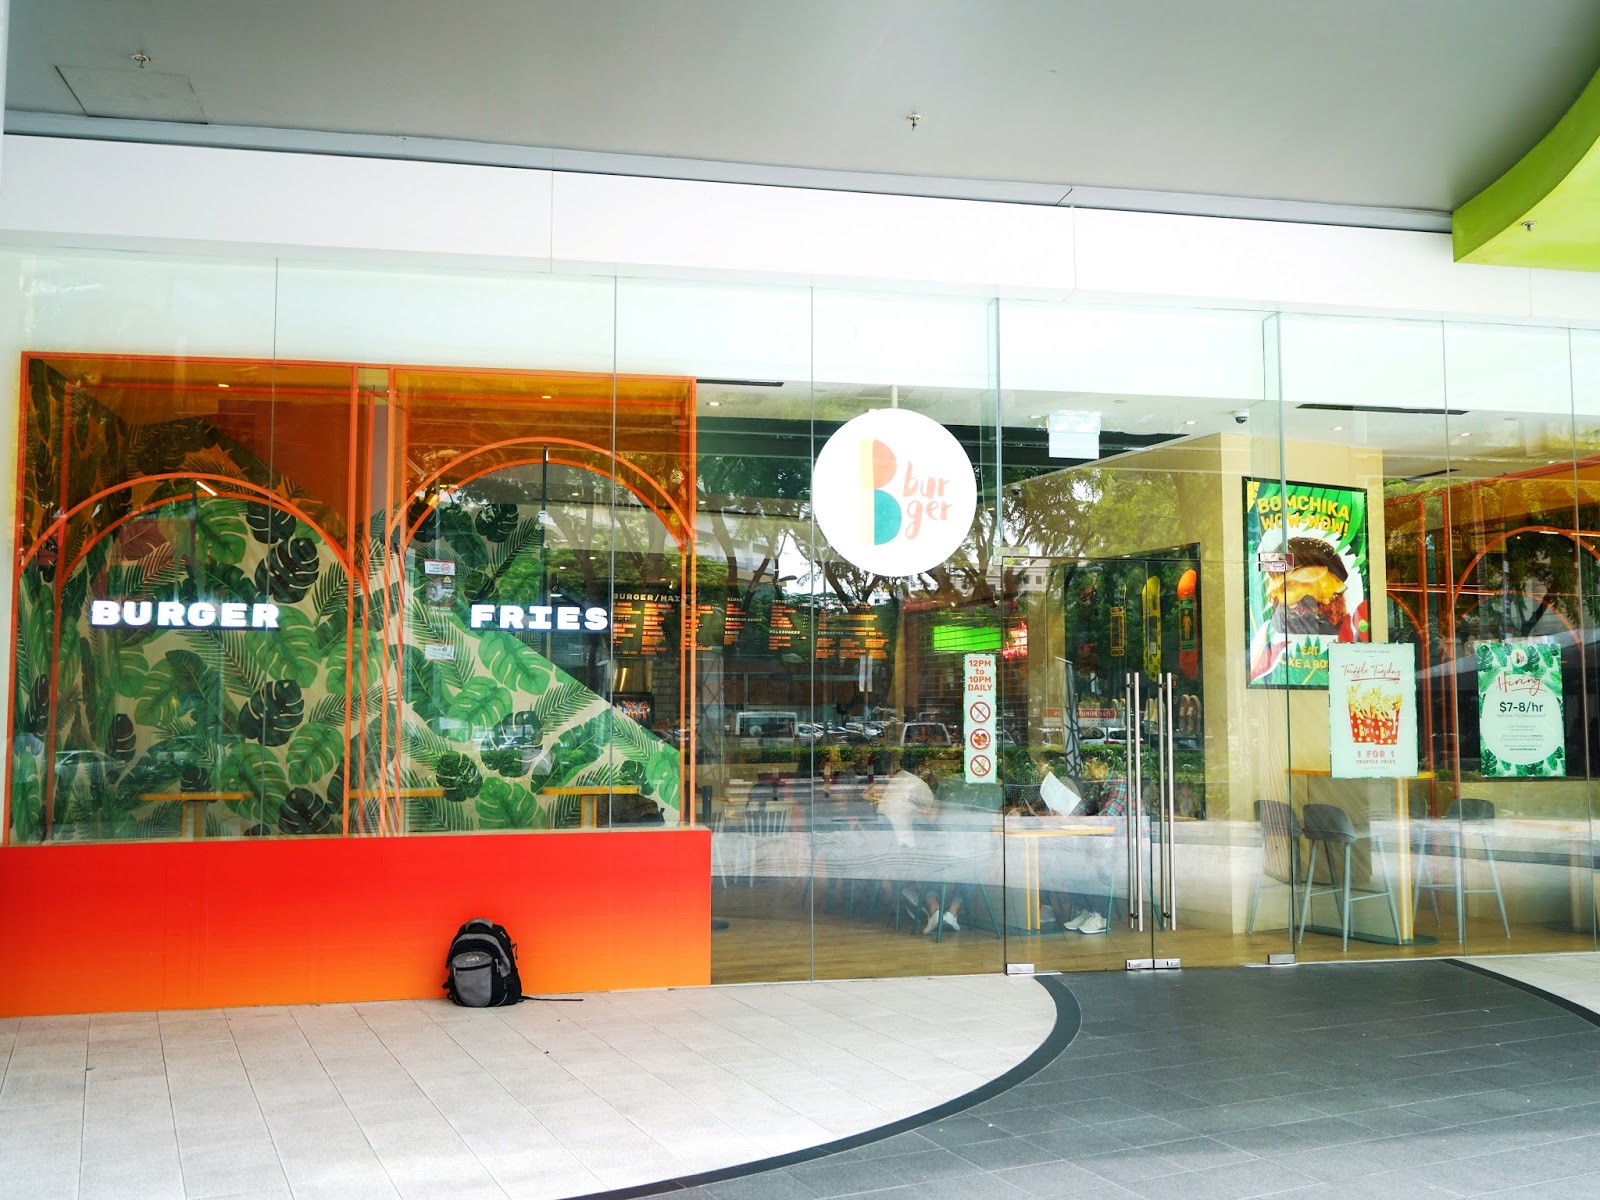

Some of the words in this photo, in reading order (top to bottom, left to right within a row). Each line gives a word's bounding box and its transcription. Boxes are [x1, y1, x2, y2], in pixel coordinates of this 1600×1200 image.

[903, 461, 949, 499] bur
[1257, 495, 1350, 521] BOMCHIKA
[905, 500, 952, 540] ger
[1260, 512, 1350, 537] WOW-WOW!
[91, 600, 280, 629] BURGER
[470, 603, 608, 630] FRIES
[1301, 645, 1319, 656] EAT
[968, 659, 991, 667] 12PM
[1303, 659, 1312, 669] A
[1371, 662, 1402, 678] Tuesday
[975, 667, 985, 675] to
[968, 675, 992, 683] 10PM
[1496, 671, 1547, 696] Hiring
[967, 684, 993, 692] DAILY
[1499, 701, 1544, 713] $7-8/hr
[1366, 750, 1386, 758] FOR
